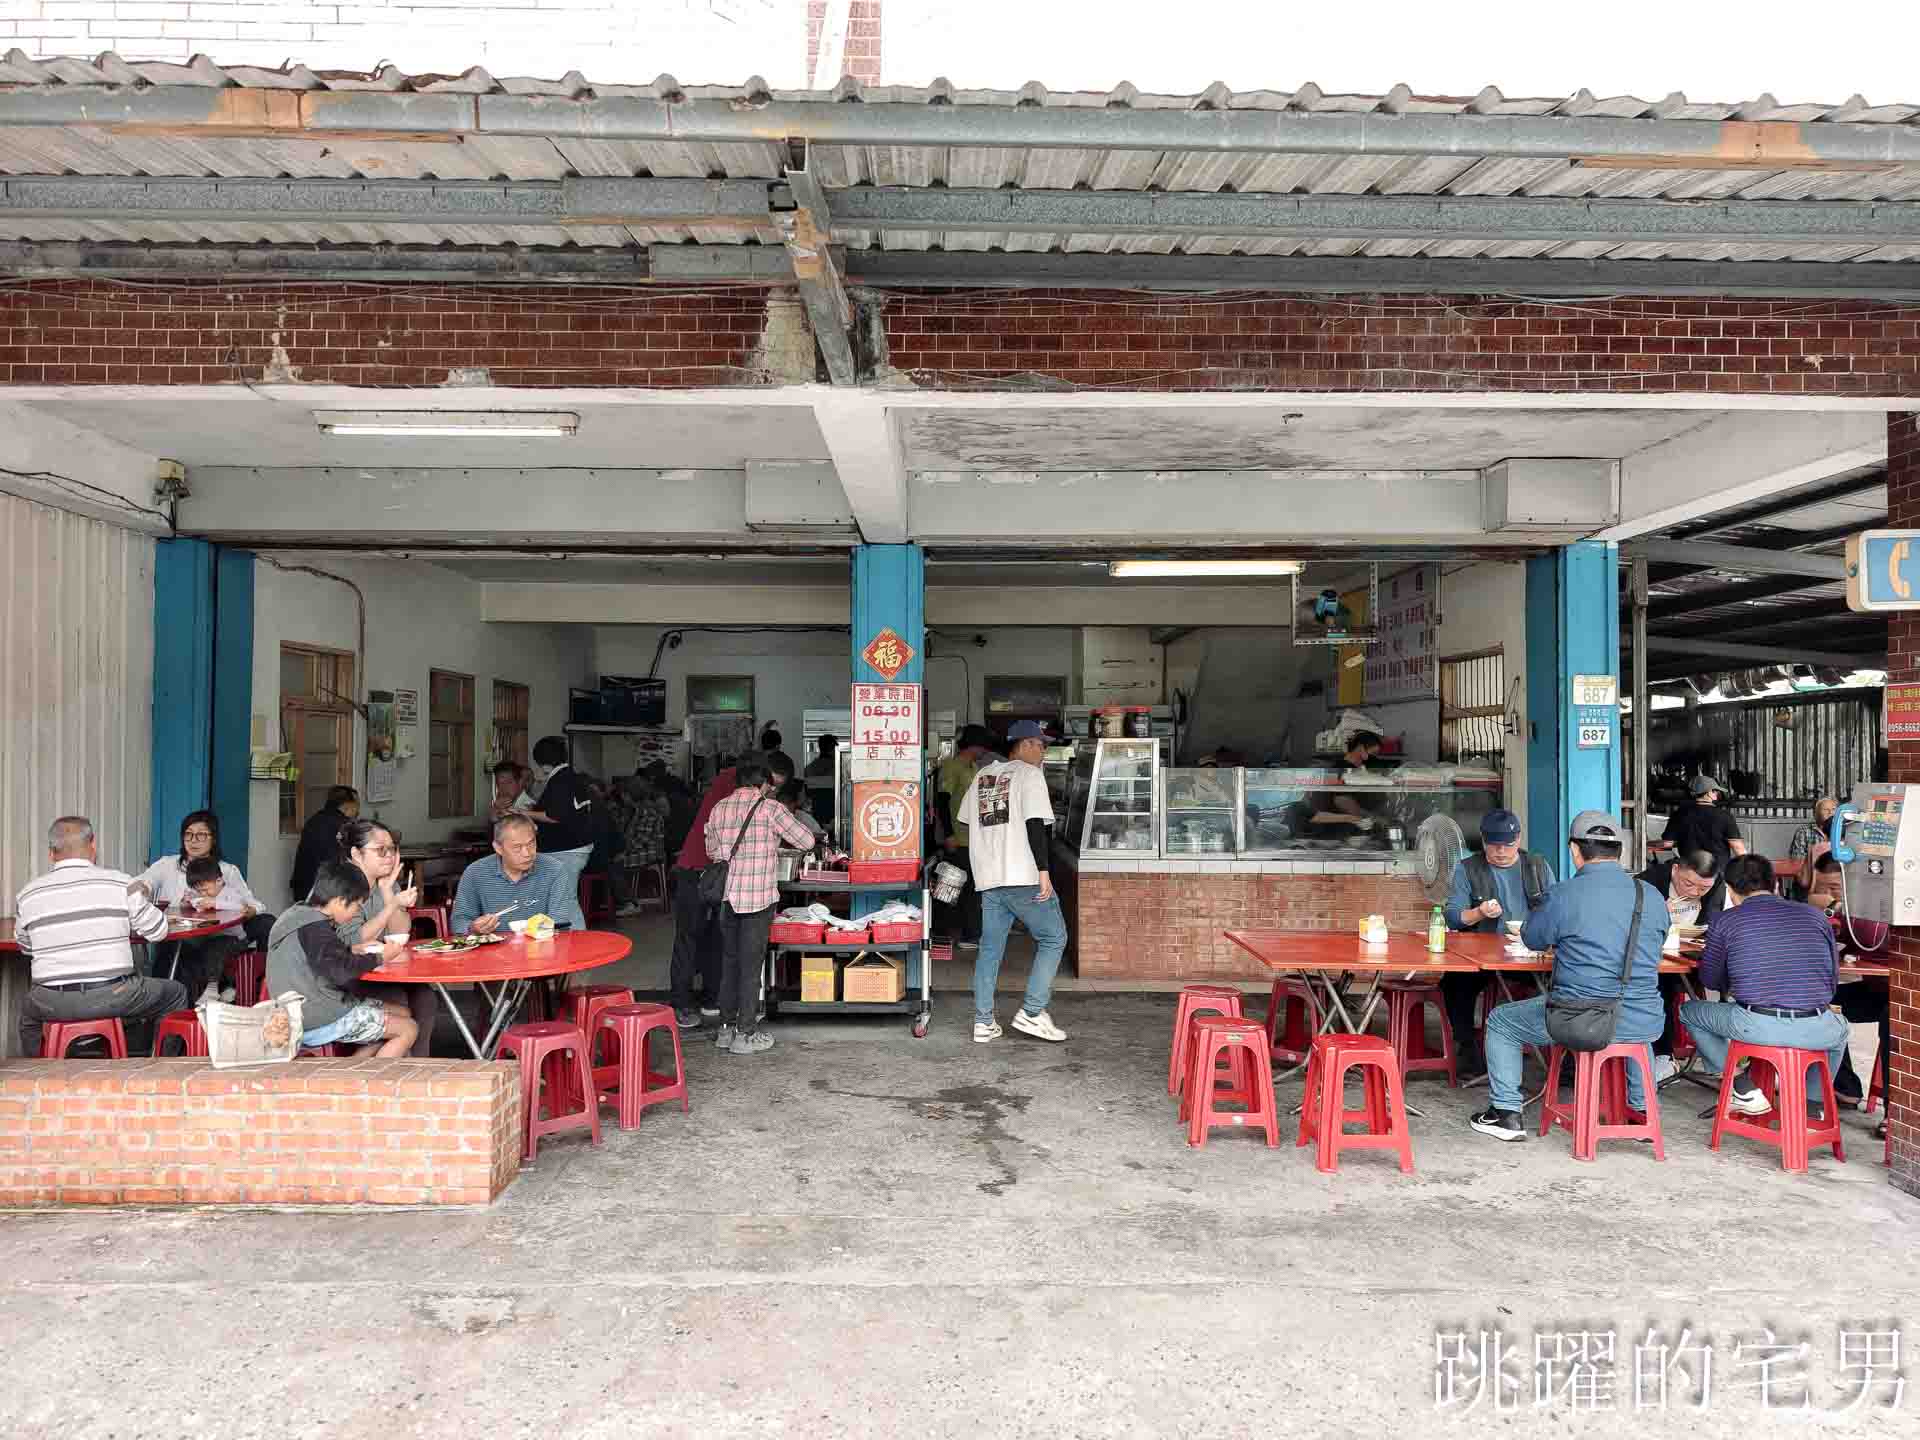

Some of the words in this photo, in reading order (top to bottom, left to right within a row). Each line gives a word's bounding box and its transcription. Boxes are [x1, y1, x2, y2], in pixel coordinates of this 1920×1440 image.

[874, 640, 902, 667] 福
[859, 688, 915, 702] 營業時間
[1583, 687, 1609, 703] 687
[1582, 729, 1607, 741] 687
